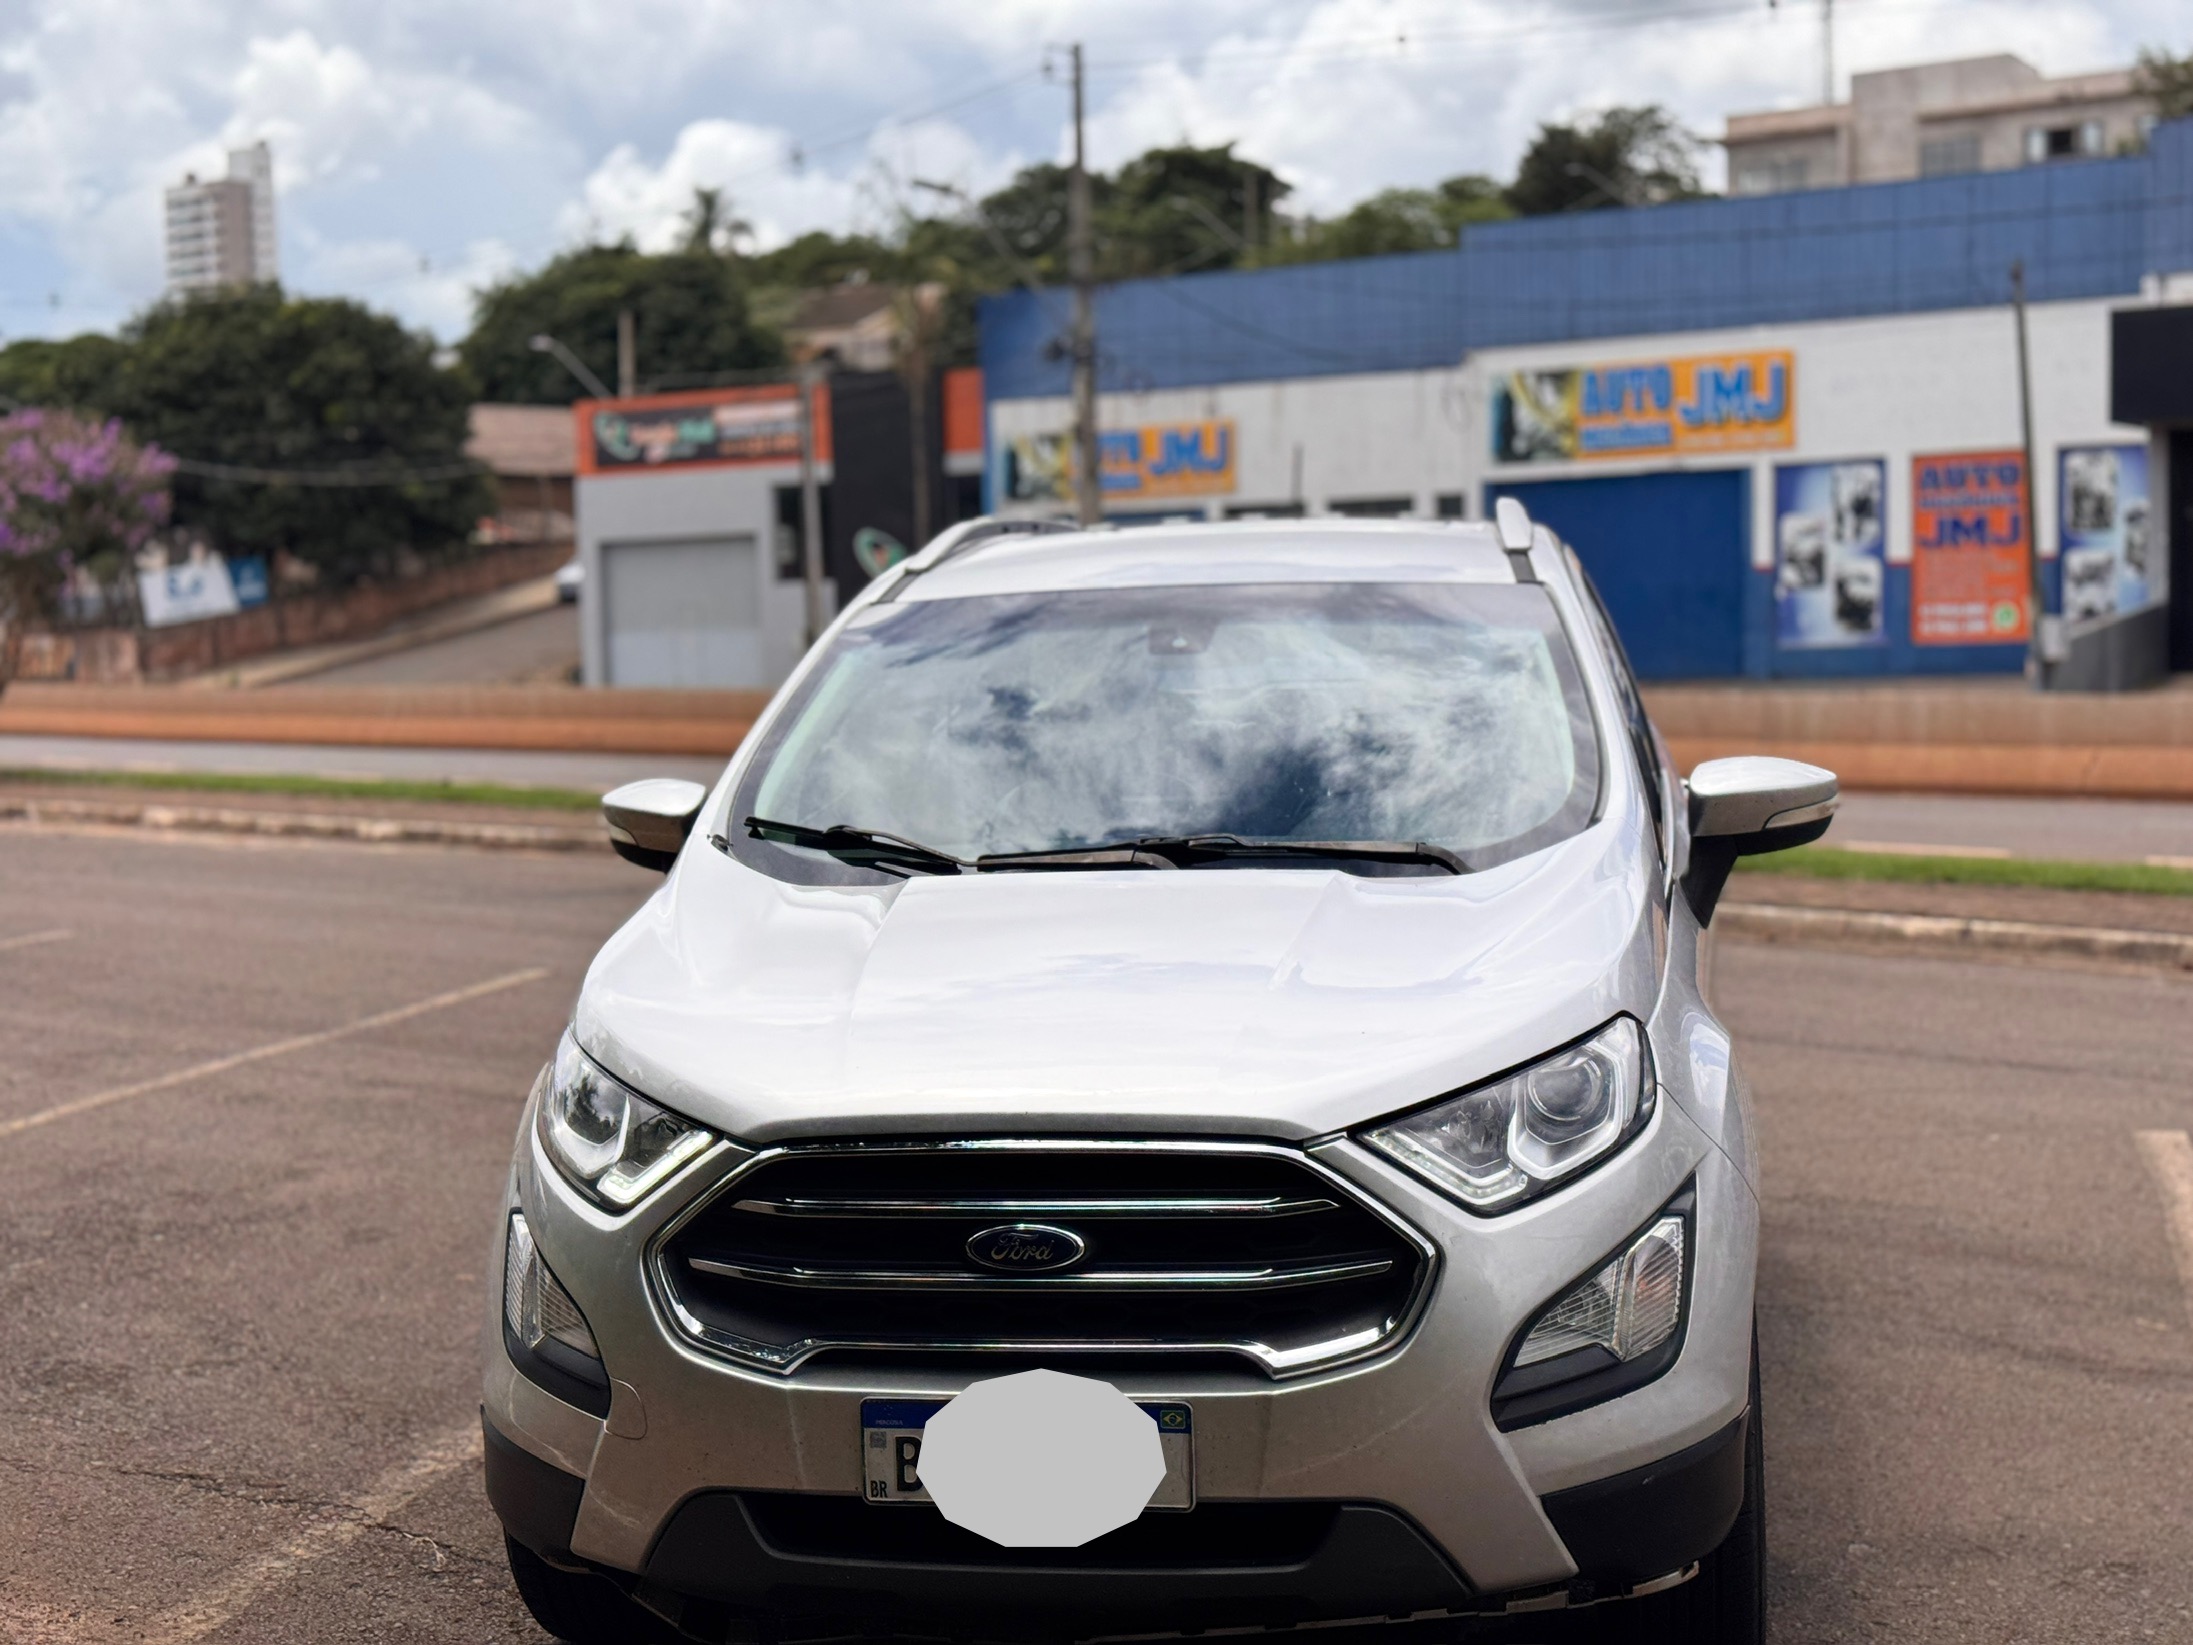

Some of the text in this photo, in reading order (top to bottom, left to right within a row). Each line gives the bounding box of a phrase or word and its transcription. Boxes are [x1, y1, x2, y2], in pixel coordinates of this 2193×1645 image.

[1582, 360, 1786, 426] AUTO JMJ
[1147, 426, 1228, 476] JMJ
[1920, 464, 2020, 490] AUTO
[1920, 514, 2021, 549] JMJ
[991, 1232, 1056, 1260] Ford
[870, 1480, 888, 1498] BR
